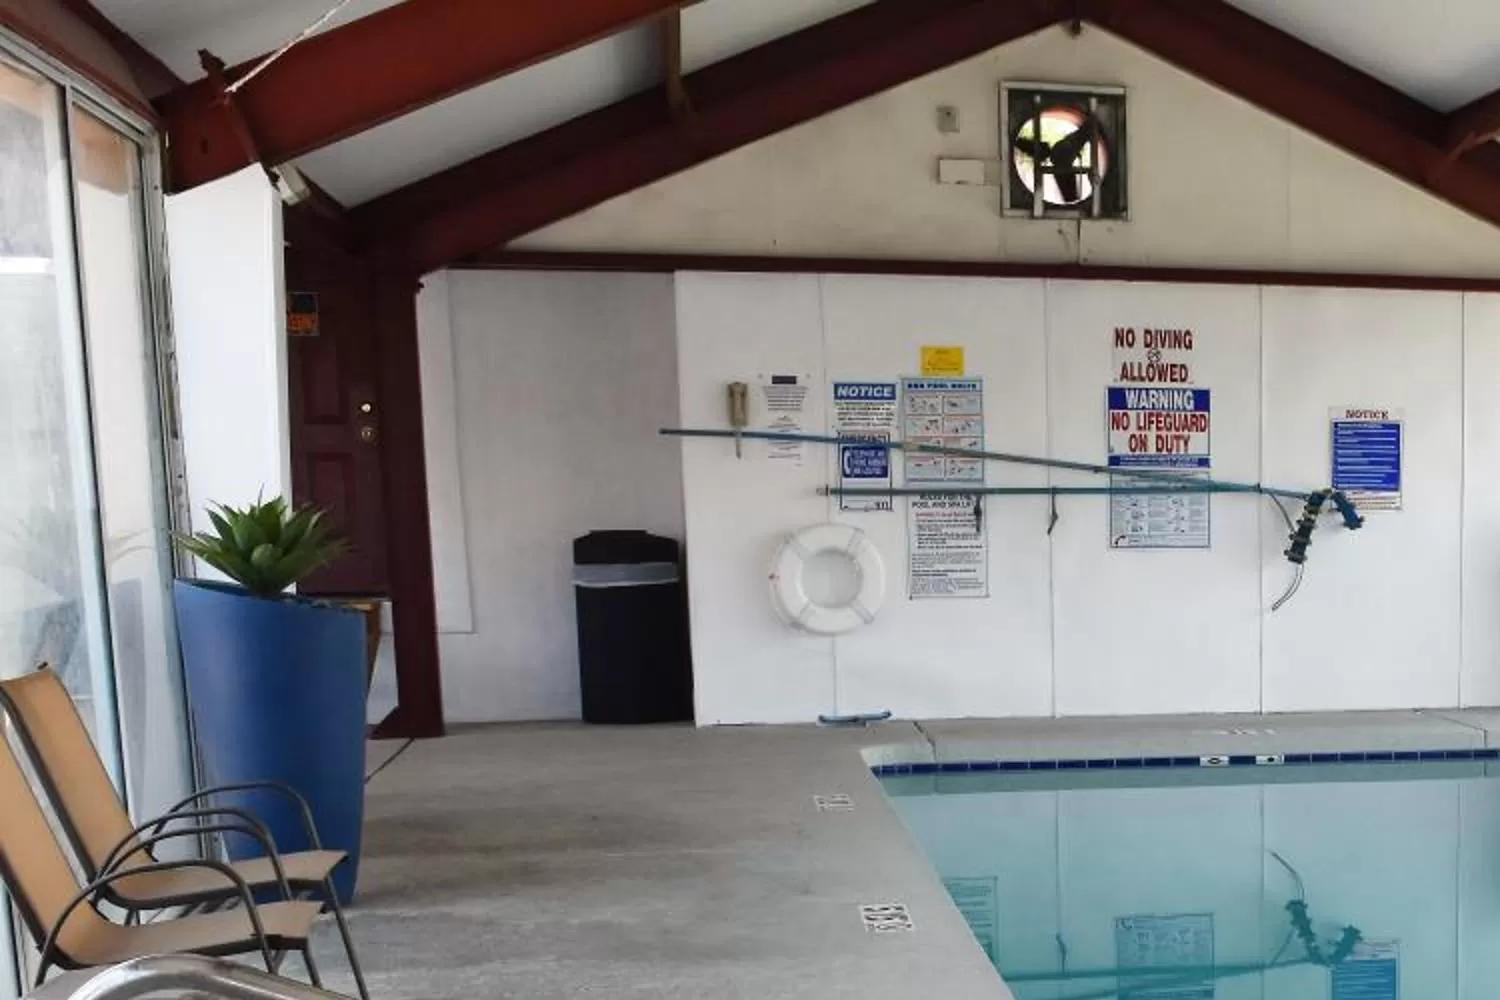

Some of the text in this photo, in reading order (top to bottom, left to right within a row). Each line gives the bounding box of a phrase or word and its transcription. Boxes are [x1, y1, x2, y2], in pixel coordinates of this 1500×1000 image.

[1115, 328, 1193, 350] NO DIVING
[1120, 362, 1188, 382] ALLOWED
[837, 386, 893, 397] NOTICE
[1125, 390, 1195, 410] WARNING
[1111, 412, 1207, 432] NO LIFEGUARD
[1345, 409, 1389, 420] NOTICE
[1129, 434, 1191, 452] ON DUTY
